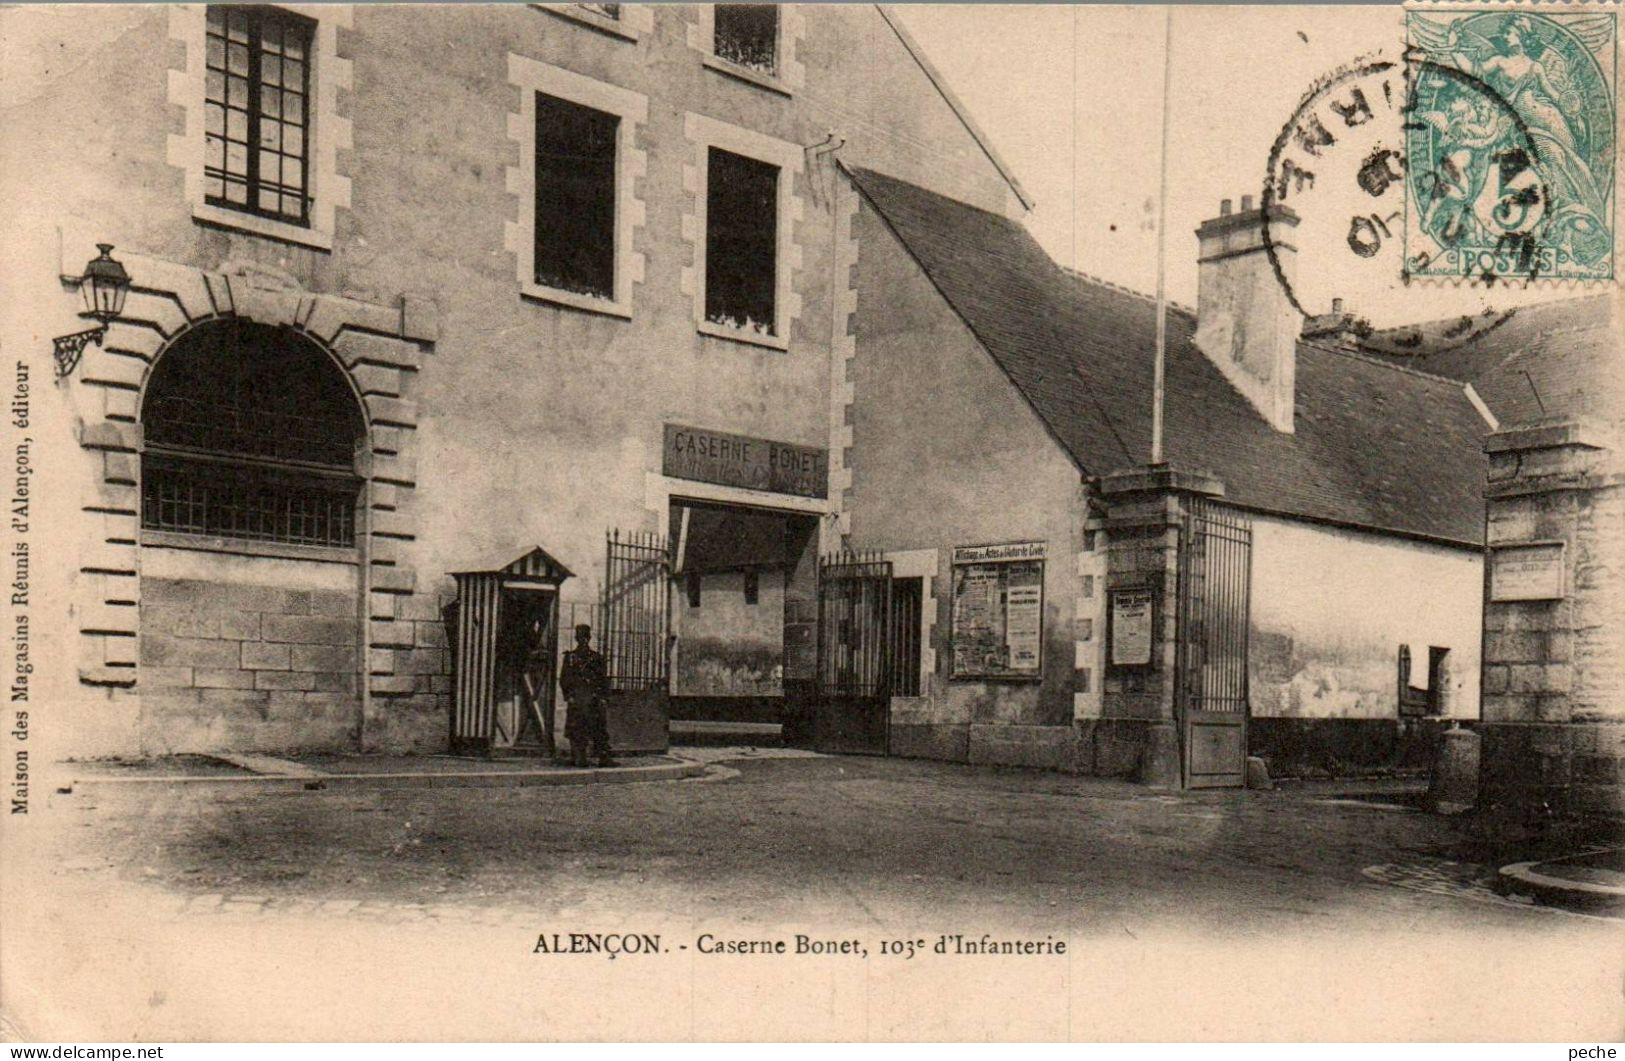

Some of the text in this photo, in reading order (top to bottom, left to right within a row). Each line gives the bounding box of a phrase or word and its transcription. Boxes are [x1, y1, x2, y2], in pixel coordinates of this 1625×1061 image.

[1463, 250, 1553, 275] POSTS
[674, 431, 820, 473] CASERNE BONET
